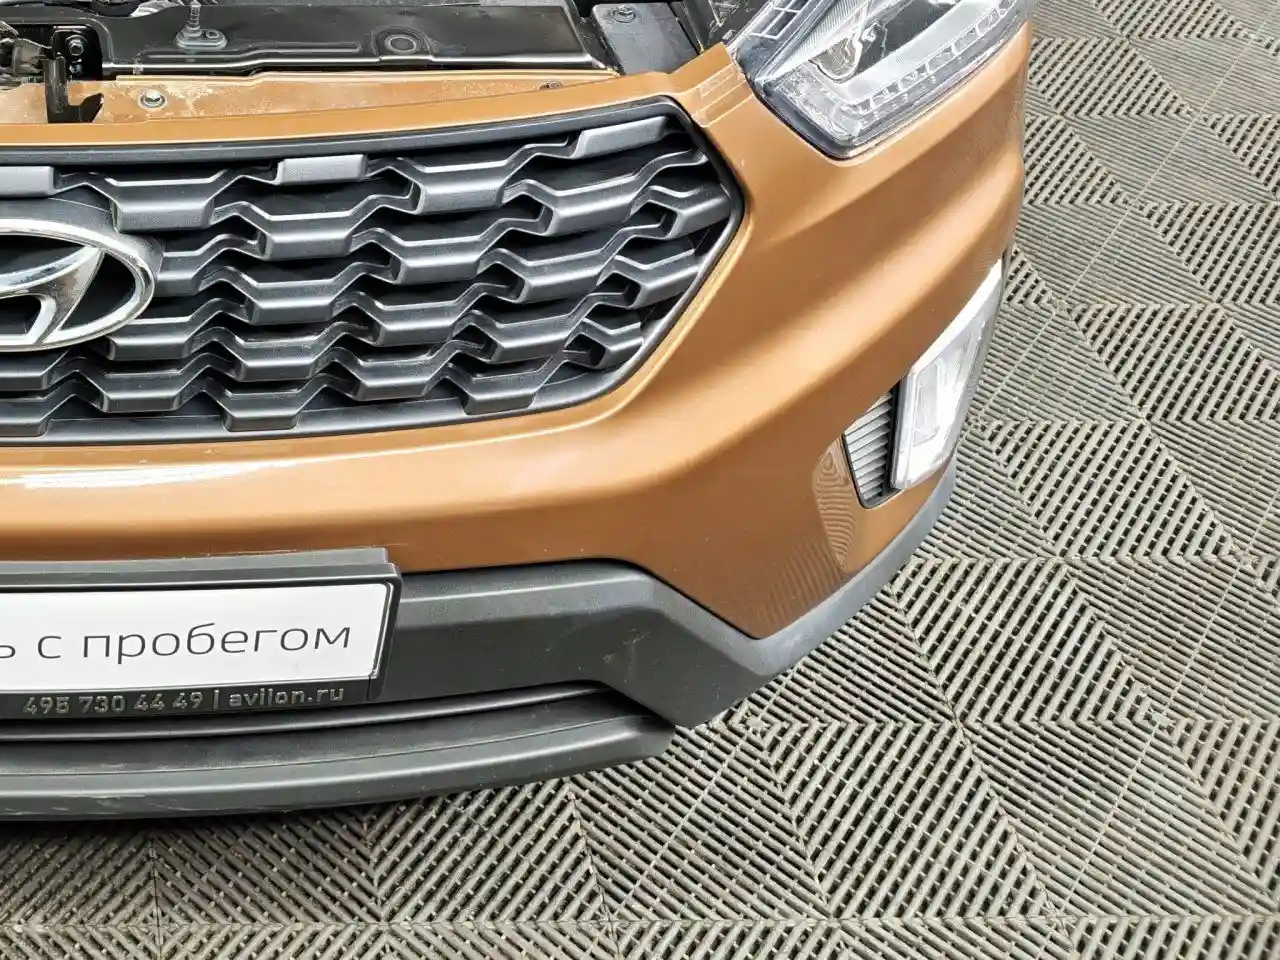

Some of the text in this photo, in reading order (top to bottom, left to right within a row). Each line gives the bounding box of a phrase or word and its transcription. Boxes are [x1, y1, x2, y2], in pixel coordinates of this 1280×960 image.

[37, 635, 62, 659] с
[83, 622, 351, 665] пробегом
[23, 688, 344, 716] 495 730 44 49 avilon.ru
